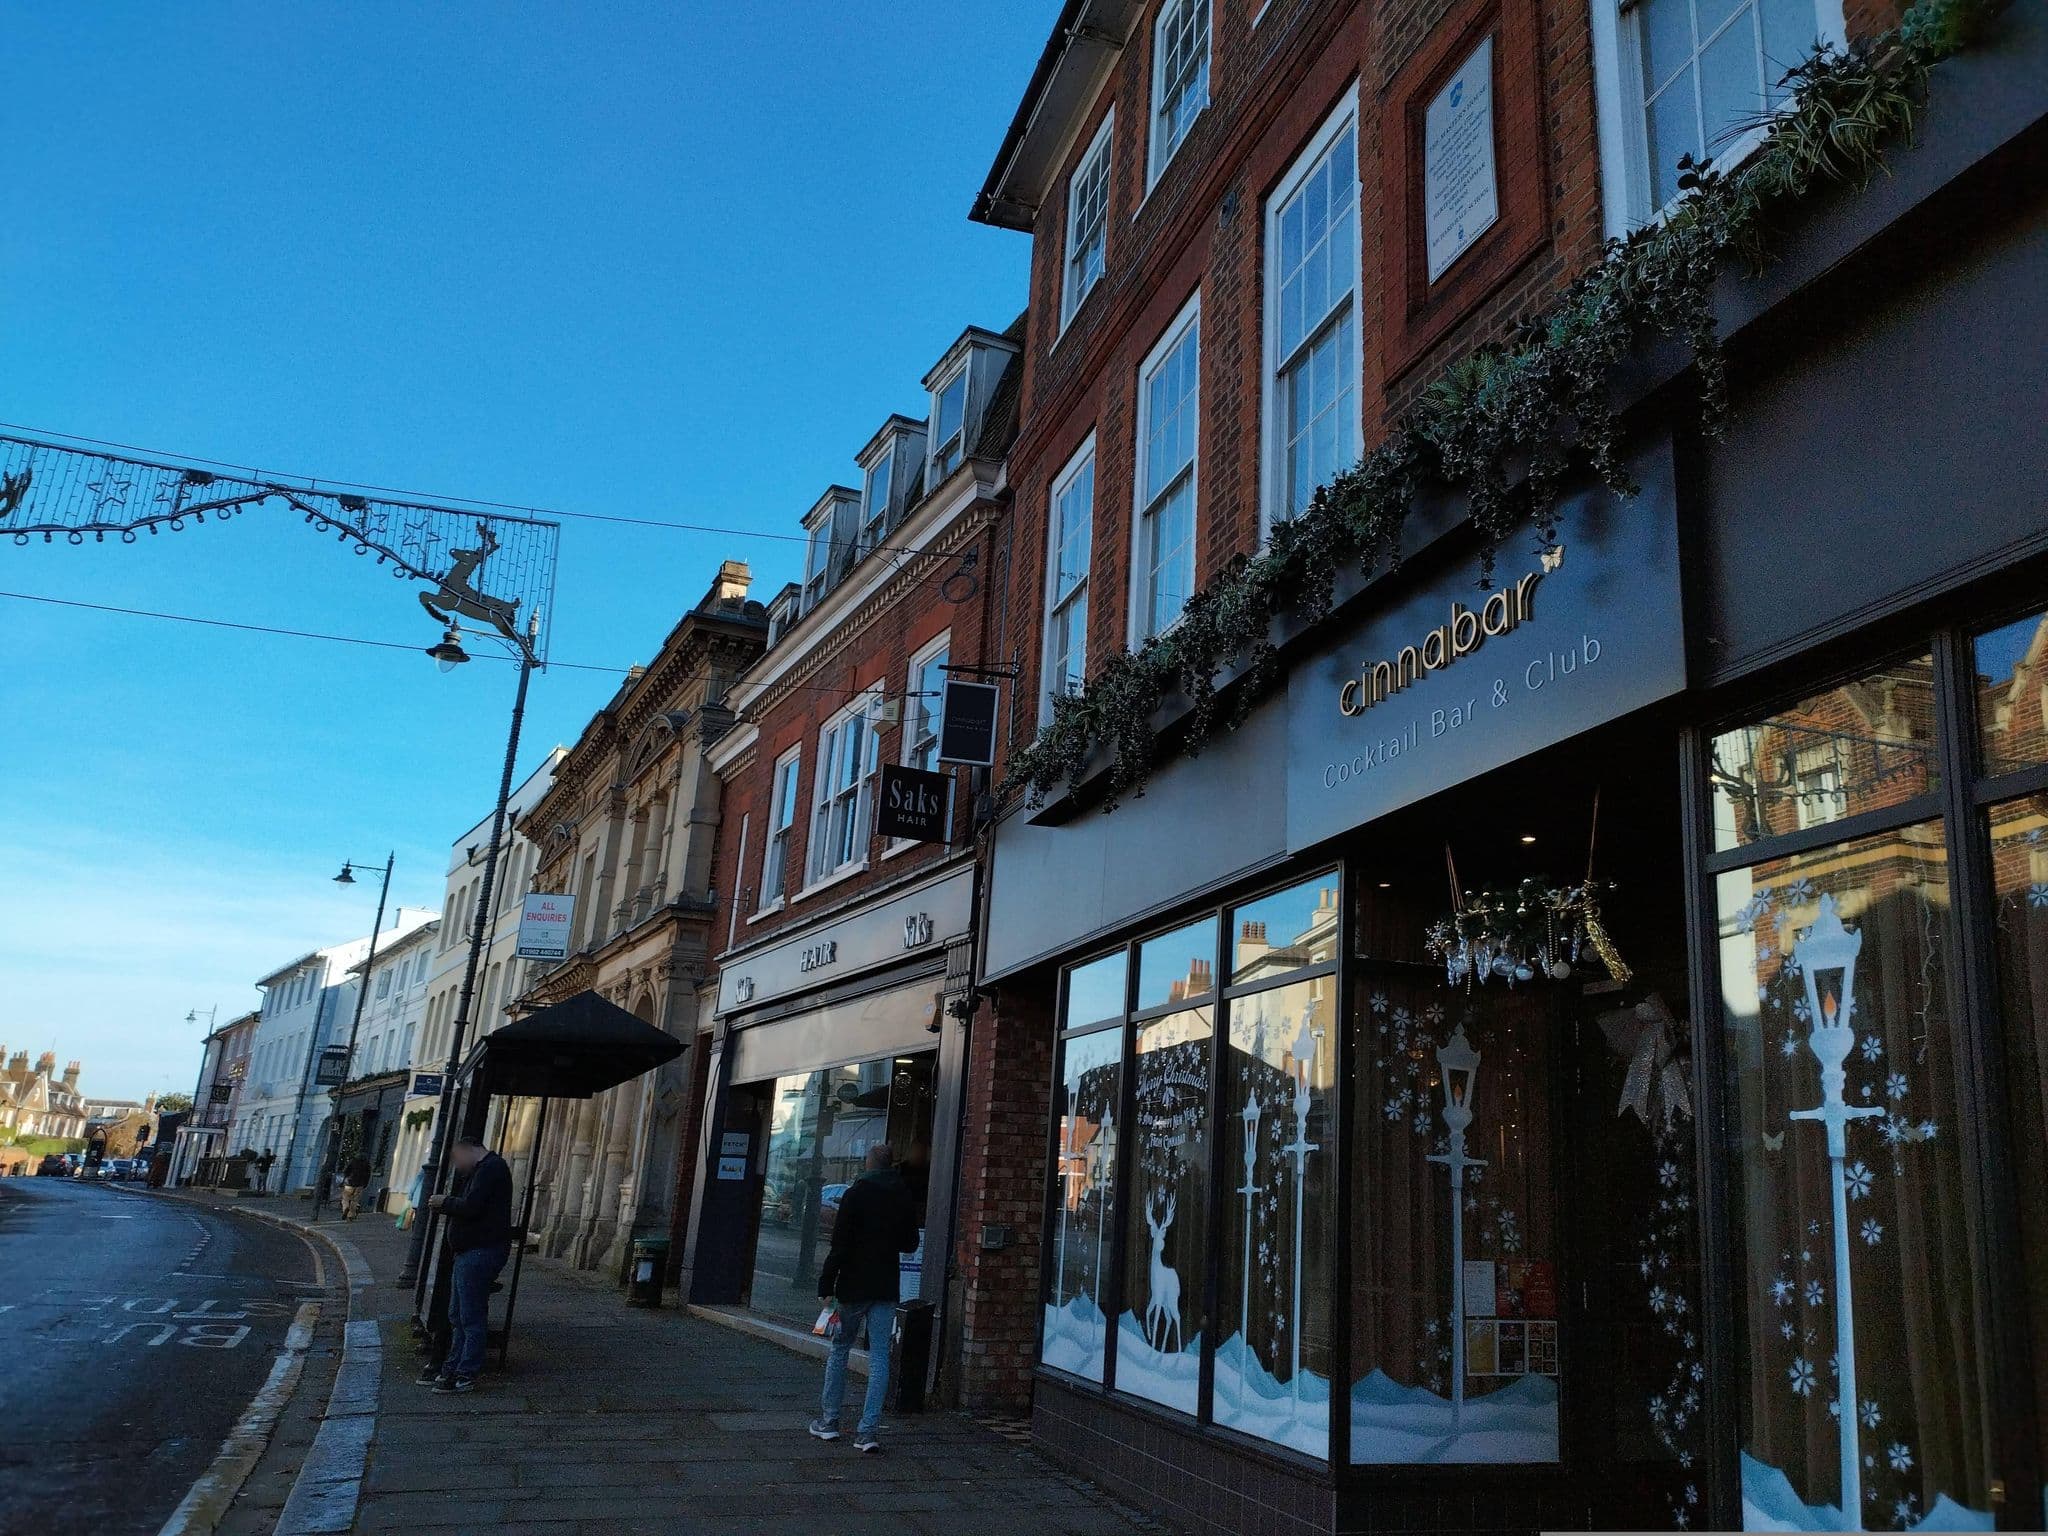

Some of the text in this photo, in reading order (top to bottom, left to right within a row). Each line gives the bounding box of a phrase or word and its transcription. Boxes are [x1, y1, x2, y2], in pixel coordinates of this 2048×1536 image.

[1340, 572, 1541, 716] cinnabar
[1324, 635, 1601, 788] Cocktail Bar & Club
[889, 778, 938, 816] Saks
[897, 813, 927, 826] HAIR
[527, 912, 567, 923] ENQUIRIES
[541, 902, 555, 911] ALL
[799, 941, 837, 972] HAIR
[1163, 1062, 1208, 1092] Christmas
